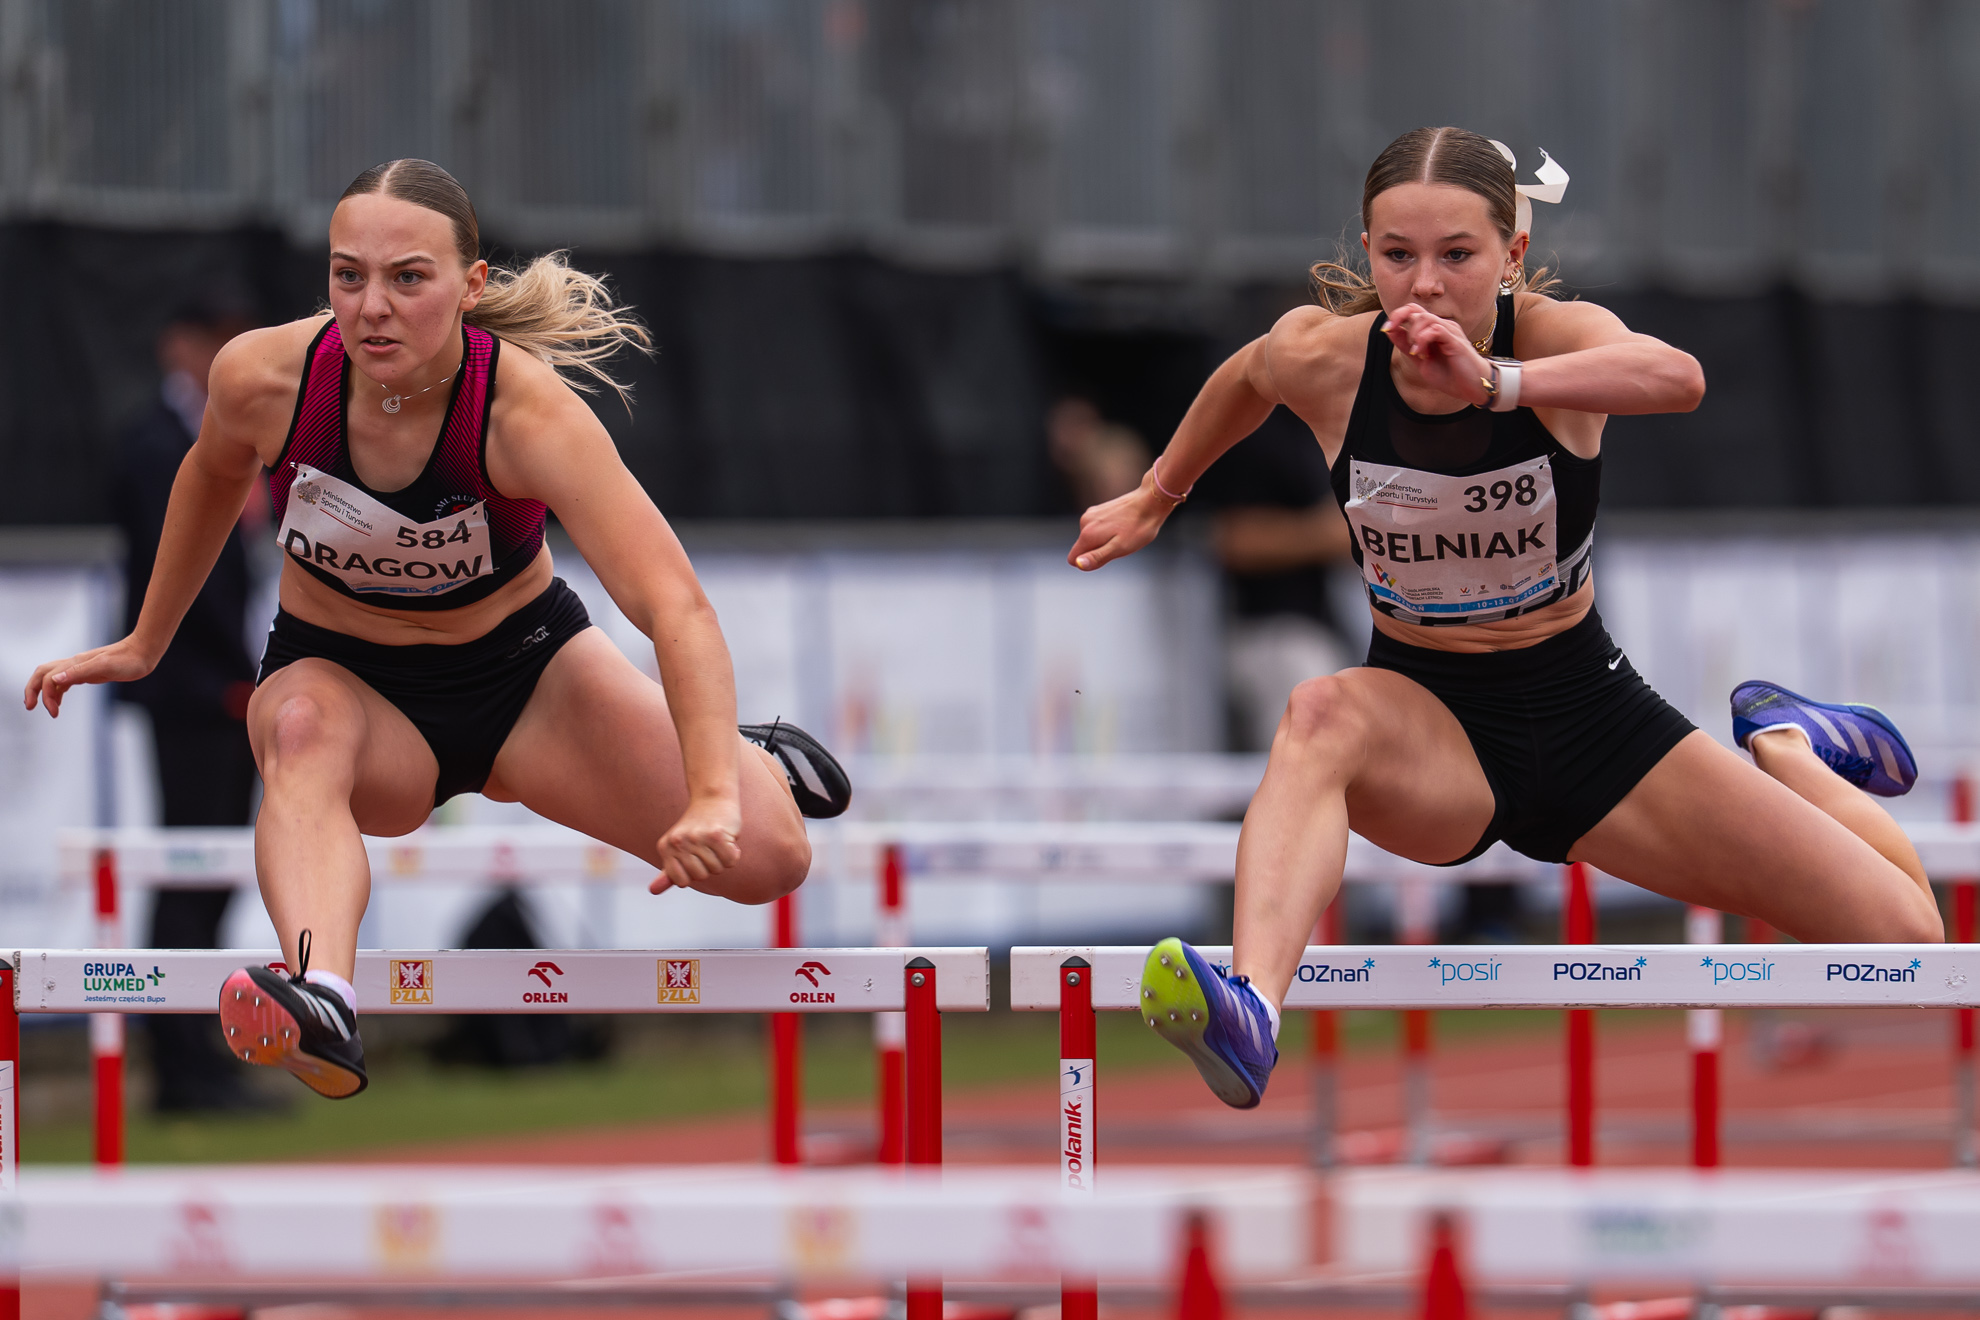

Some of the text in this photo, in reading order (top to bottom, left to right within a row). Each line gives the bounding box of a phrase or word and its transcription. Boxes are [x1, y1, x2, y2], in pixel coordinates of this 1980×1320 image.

[1375, 490, 1400, 500] Sportu
[1405, 493, 1438, 504] Turystyki
[1378, 481, 1422, 494] Mnisterstwo
[1463, 474, 1537, 513] 398
[322, 489, 362, 516] Ministerstwo
[320, 497, 341, 513] Sportu
[345, 510, 373, 530] Turystyki
[395, 519, 472, 549] 584
[1360, 521, 1546, 564] BELNIAK
[284, 528, 484, 580] DRAGOW
[84, 962, 136, 977] GRUPA
[1441, 958, 1503, 986] posir
[1714, 957, 1775, 986] posir
[84, 977, 146, 992] LUXMED
[84, 995, 166, 1004] Jesteśmy częścią Bupa
[392, 989, 431, 1002] PZLA
[522, 992, 569, 1004] ORLEN
[659, 989, 698, 1002] PZLA
[789, 992, 835, 1004] ORLEN
[1063, 1100, 1087, 1192] polanik
